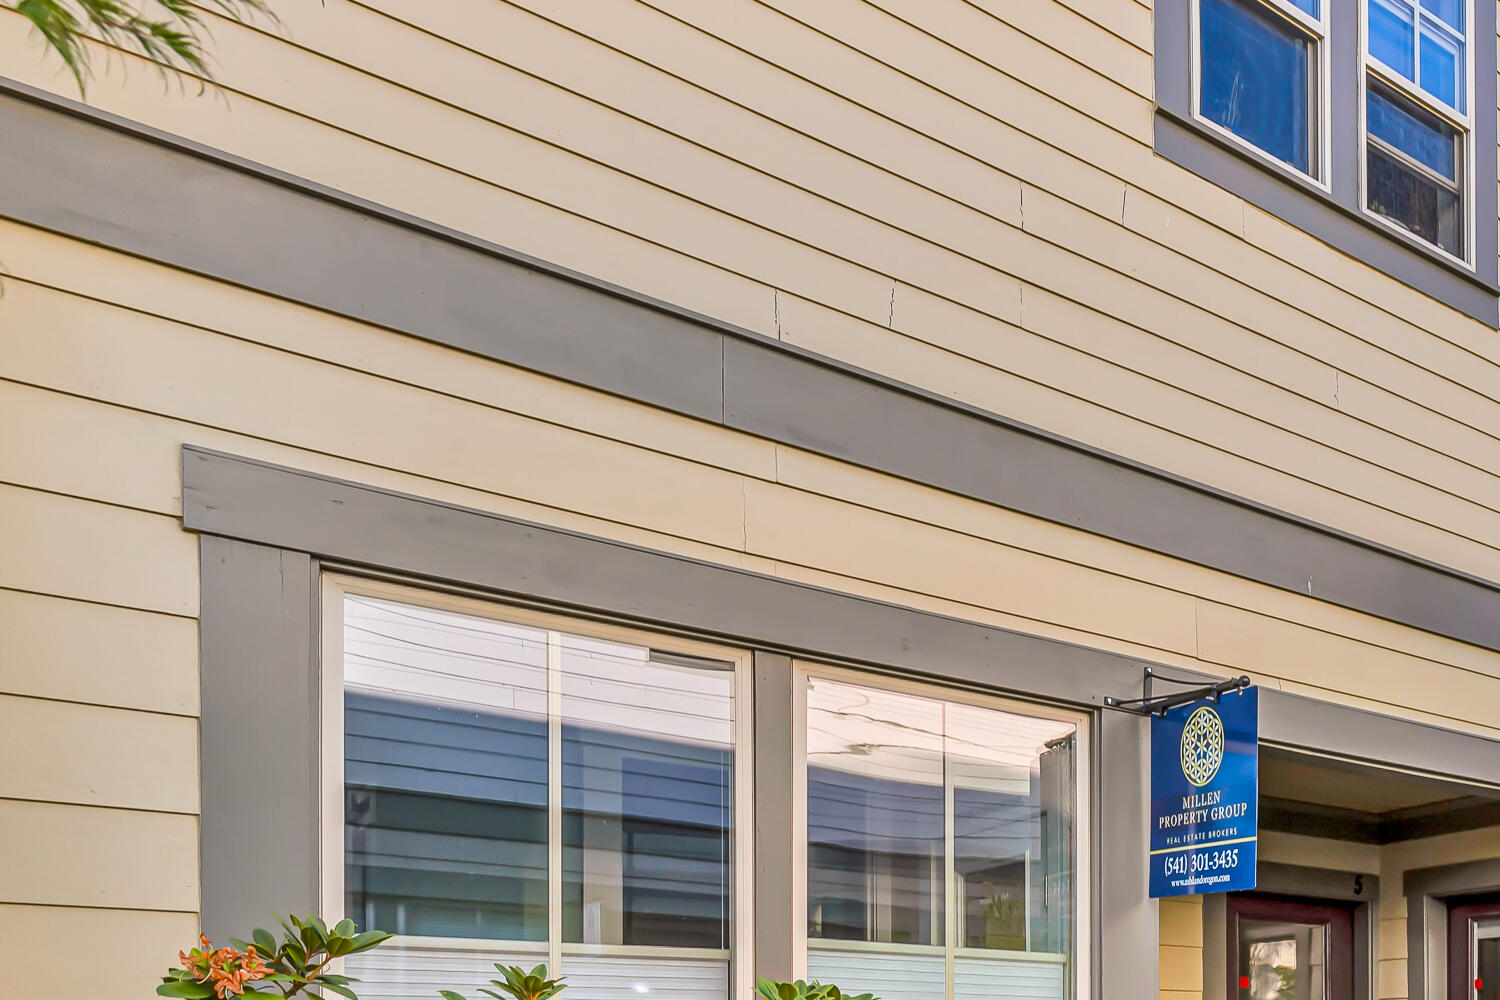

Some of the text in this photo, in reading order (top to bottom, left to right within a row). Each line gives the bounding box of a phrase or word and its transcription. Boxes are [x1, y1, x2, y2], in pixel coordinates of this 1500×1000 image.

[1182, 790, 1221, 809] MILLEN
[1159, 802, 1248, 829] PROPERTY GROUP
[1166, 827, 1238, 845] REAL ESTATE BROKERS
[1165, 849, 1238, 877] (541) 301-3435
[1353, 875, 1363, 895] 5
